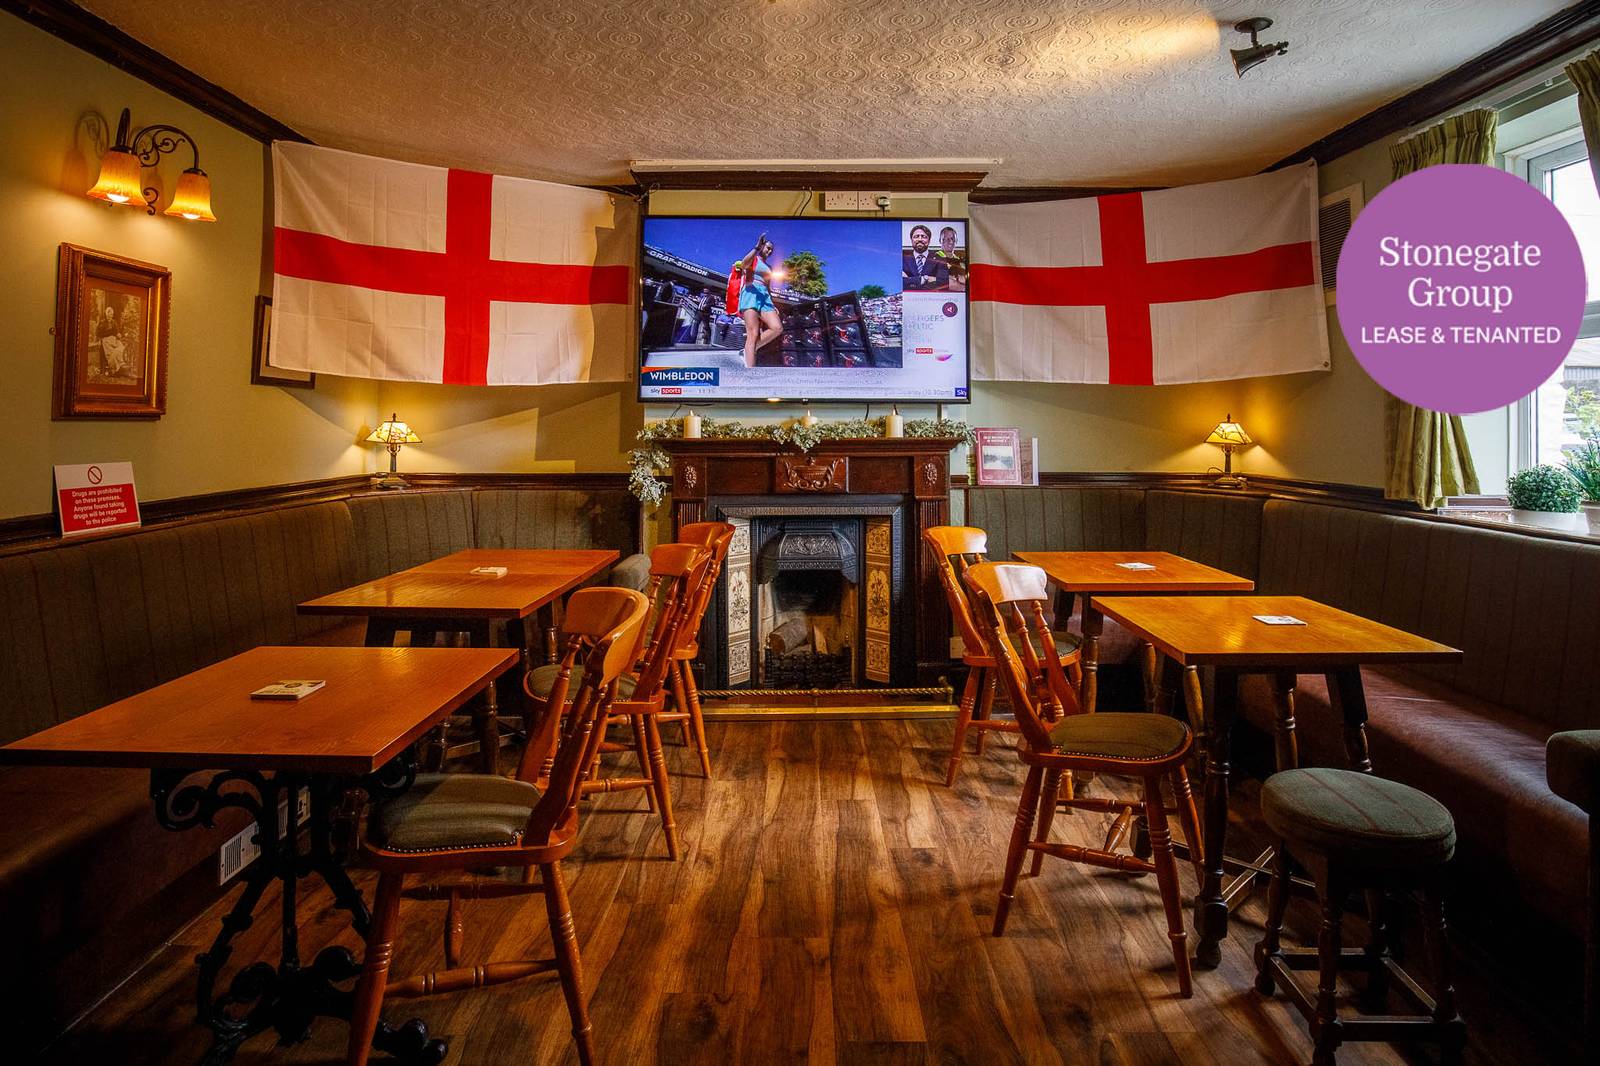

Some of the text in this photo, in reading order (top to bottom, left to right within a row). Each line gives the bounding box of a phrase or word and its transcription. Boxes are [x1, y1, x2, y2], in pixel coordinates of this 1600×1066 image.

[650, 371, 714, 381] WIMBLEDON
[650, 387, 661, 395] sky
[73, 505, 94, 513] Anyone
